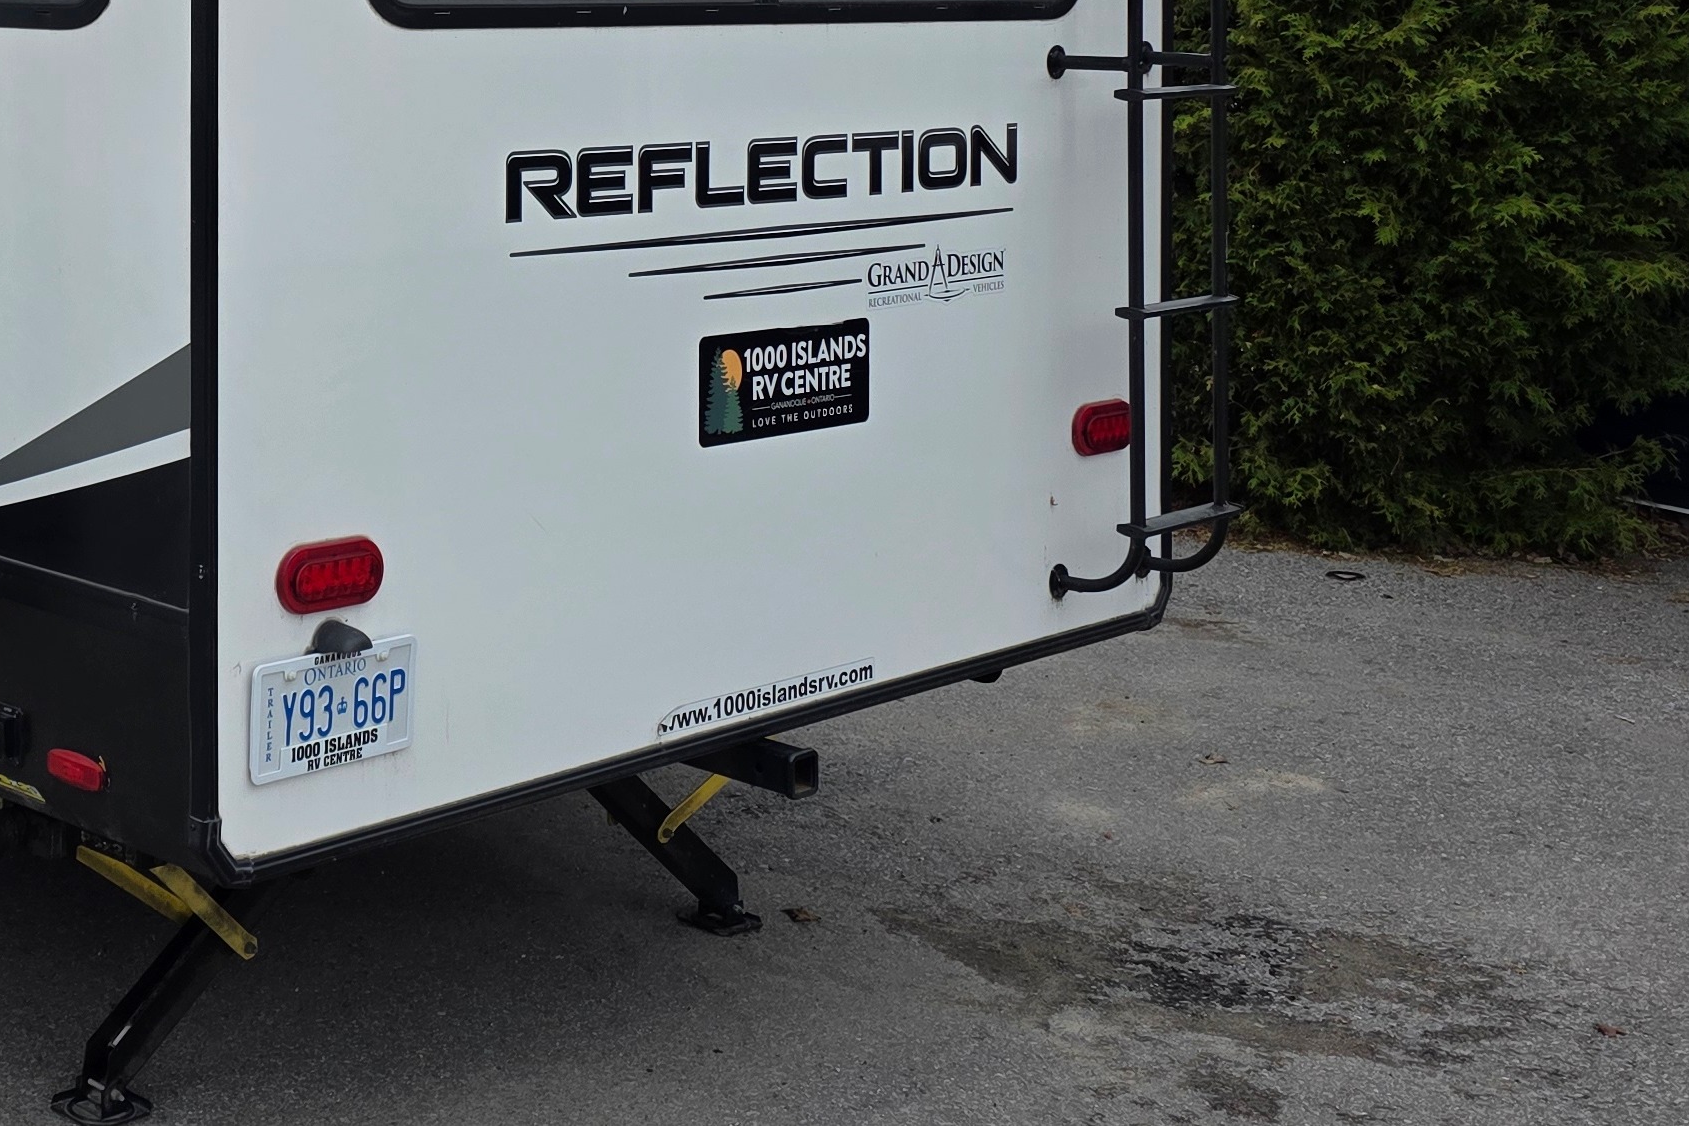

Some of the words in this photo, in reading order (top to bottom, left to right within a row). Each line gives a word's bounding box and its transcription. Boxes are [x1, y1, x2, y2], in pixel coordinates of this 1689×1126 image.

[506, 122, 1019, 223] REFLECTION
[867, 260, 929, 287] GRAND
[946, 250, 1004, 277] DESIGN
[868, 292, 922, 308] RECREATIONAL
[972, 280, 1005, 293] VEHICLES
[743, 344, 788, 373] 1000
[791, 333, 867, 367] ISLANDS
[752, 373, 778, 400] RV
[780, 363, 852, 396] CENTRE
[752, 415, 777, 428] LOVE
[781, 412, 799, 423] THE
[803, 403, 854, 420] OUTDOORS
[770, 399, 807, 410] GANANOQUE
[810, 393, 836, 405] ONTARIO
[304, 658, 367, 686] ONTARIO
[265, 687, 274, 762] TRAILER
[282, 685, 334, 747] Y93
[353, 668, 406, 728] 66P
[291, 743, 321, 763] 1000
[324, 728, 379, 755] ISLANDS
[307, 759, 321, 772] RV
[323, 747, 363, 767] CENTRE
